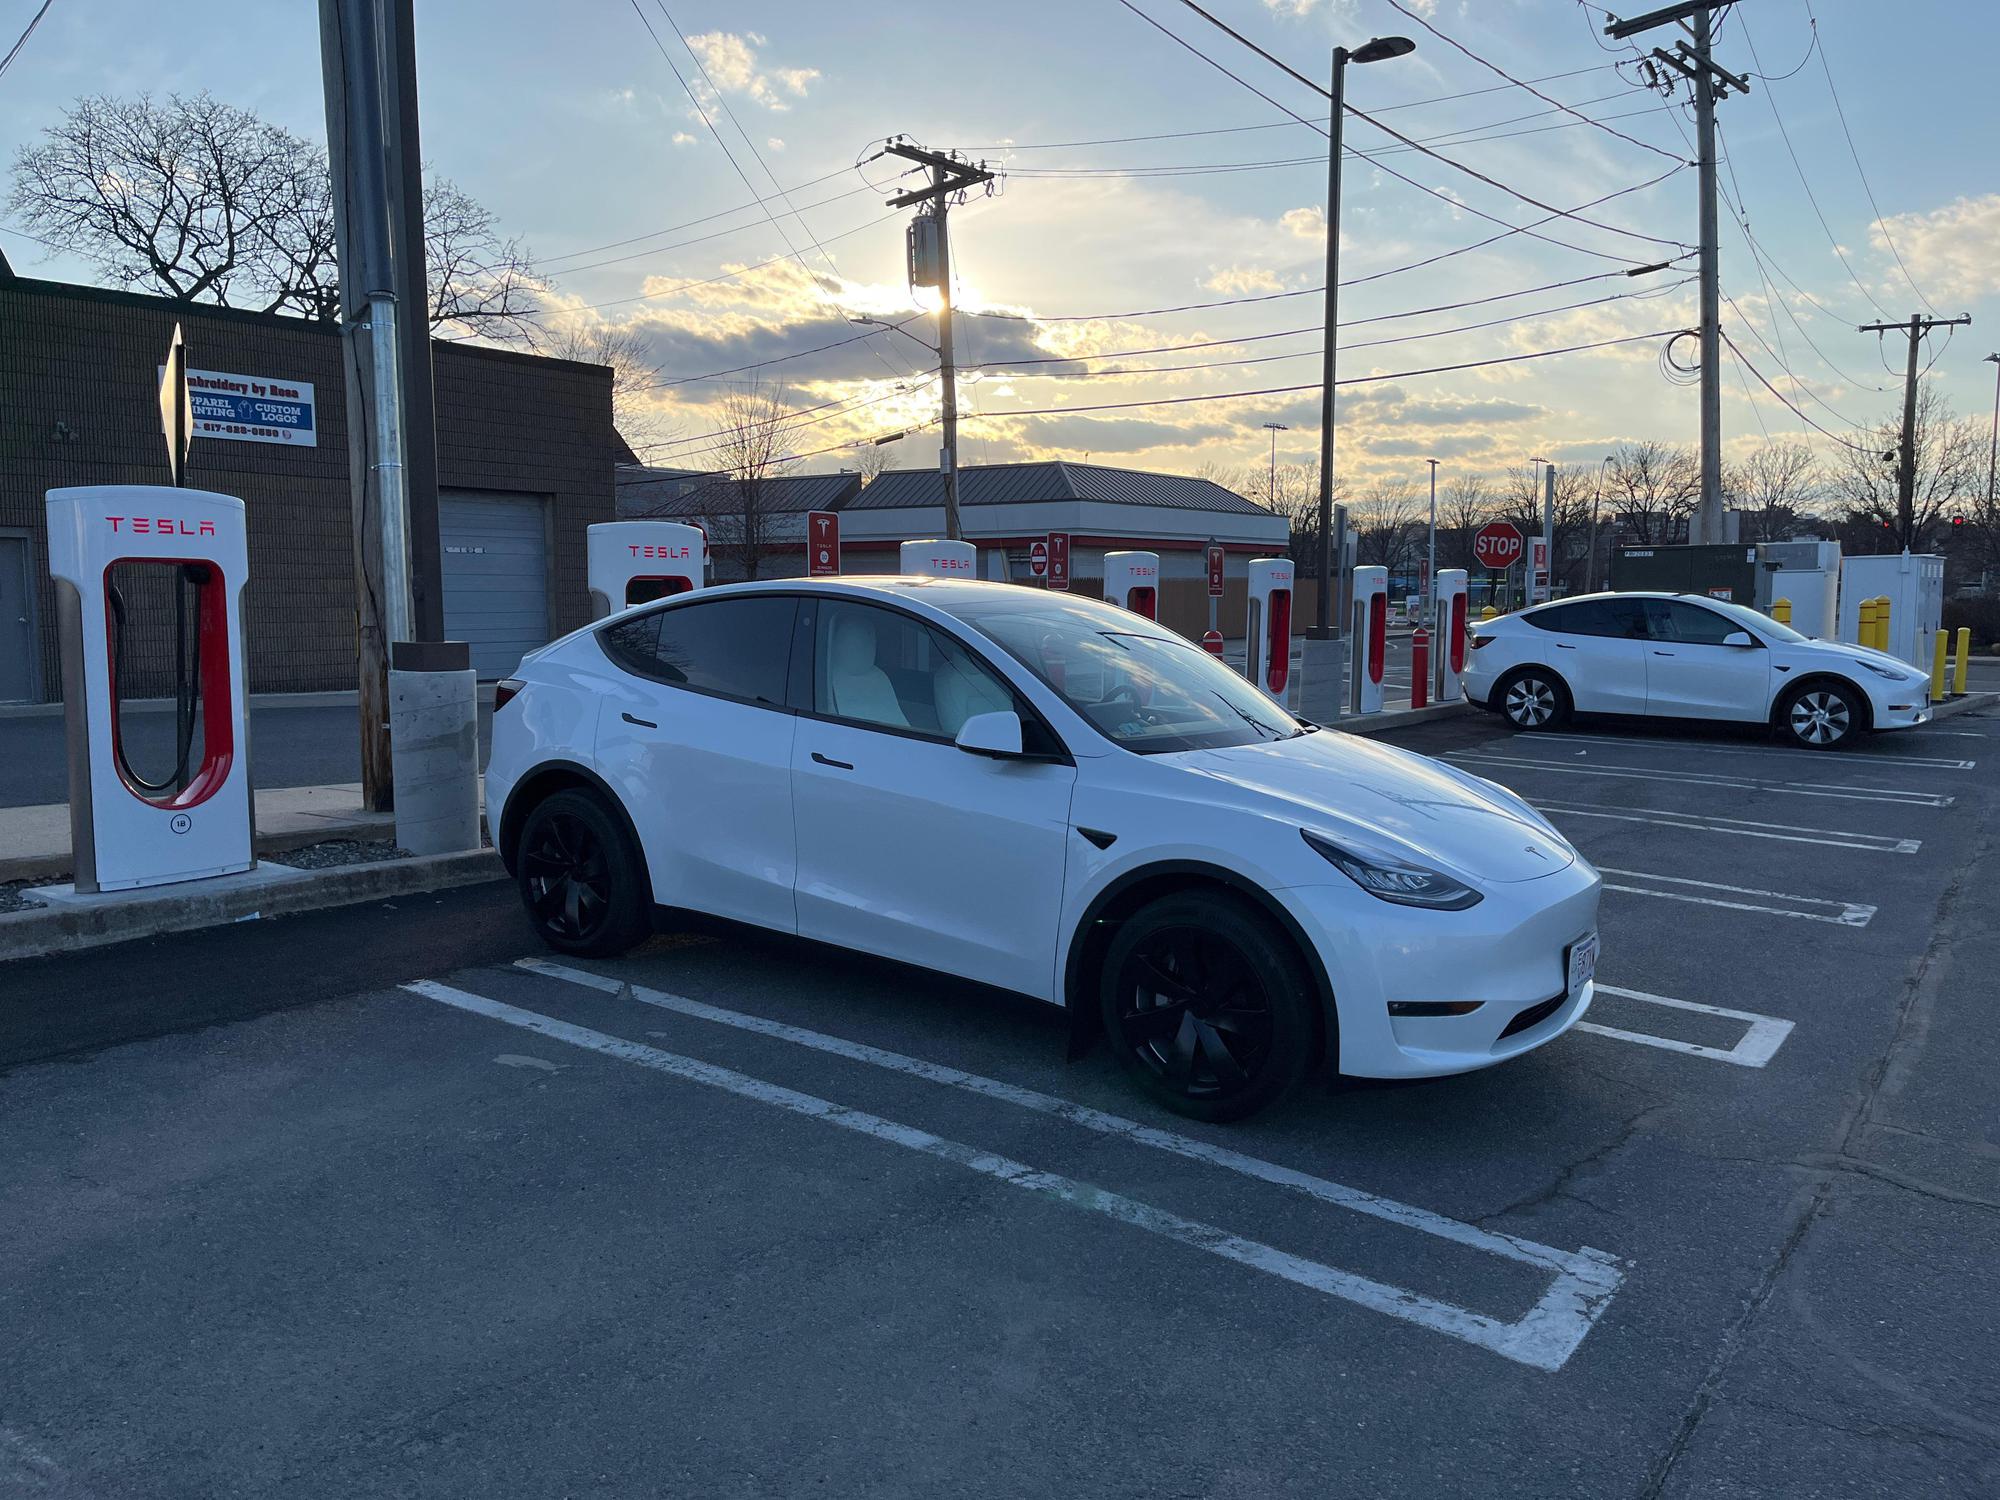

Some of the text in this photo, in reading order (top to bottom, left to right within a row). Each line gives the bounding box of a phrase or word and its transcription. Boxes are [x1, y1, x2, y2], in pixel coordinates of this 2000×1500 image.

[187, 375, 299, 399] mbroidery by Rosa
[190, 396, 232, 408] PPAREL
[192, 405, 236, 418] INTING
[254, 403, 302, 416] CUSTOM
[261, 412, 298, 424] LOGOS
[104, 516, 215, 536] TESLA
[627, 545, 689, 559] TESLA
[1476, 535, 1520, 556] STOP
[931, 559, 969, 569] TESLA
[176, 820, 186, 828] 1B
